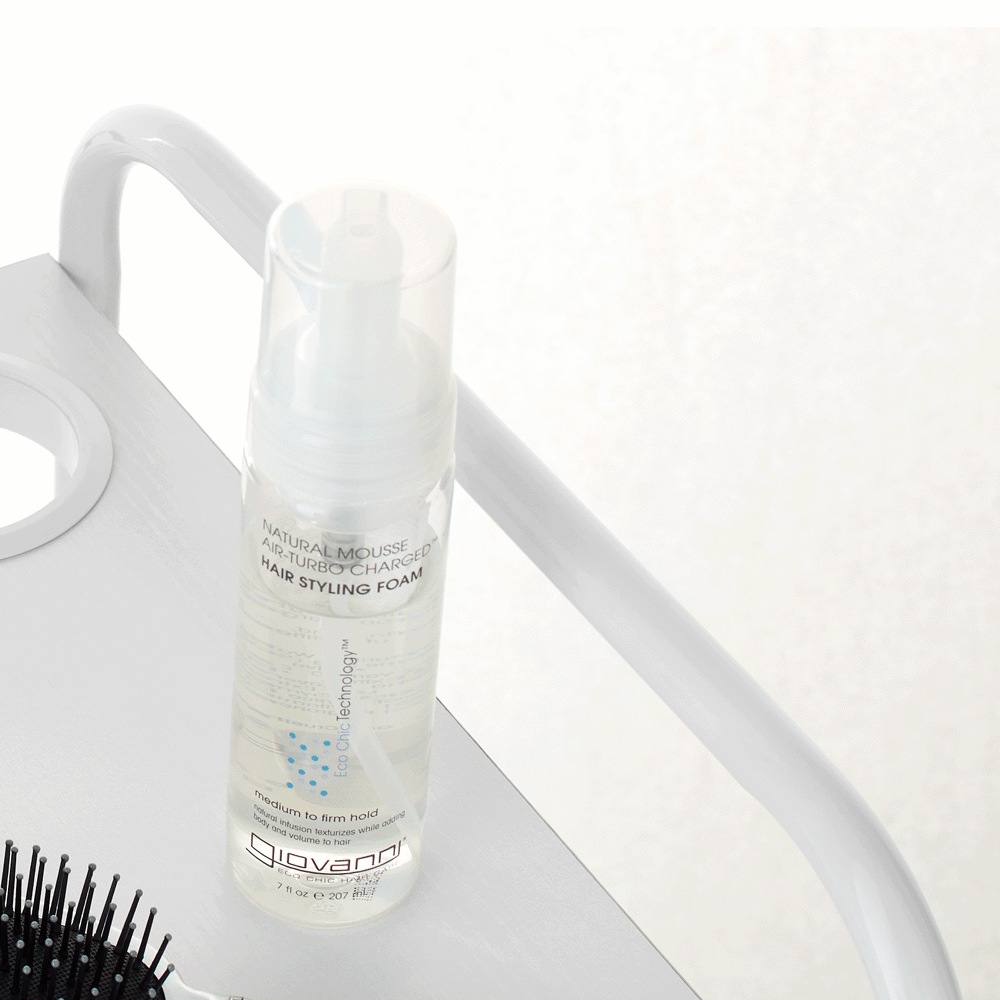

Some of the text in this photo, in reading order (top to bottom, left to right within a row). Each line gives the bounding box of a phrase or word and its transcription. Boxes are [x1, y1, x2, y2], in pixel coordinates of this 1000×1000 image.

[262, 518, 409, 560] NATURAL MOUSSE
[262, 537, 344, 576] AIR-TURBO
[261, 555, 423, 596] HAIR STYLING FOAM
[336, 722, 351, 751] Chic
[334, 753, 348, 778] Eco
[253, 803, 406, 837] natural infusion texturizes while adding
[255, 789, 379, 823] medium to firm hold
[253, 812, 270, 829] body
[271, 825, 287, 837] and
[289, 832, 320, 845] volume
[277, 867, 301, 880] ECO
[305, 875, 335, 884] CHIC
[277, 881, 283, 890] 7
[286, 884, 293, 894] fl
[295, 889, 309, 898] oz
[328, 891, 349, 901] 207
